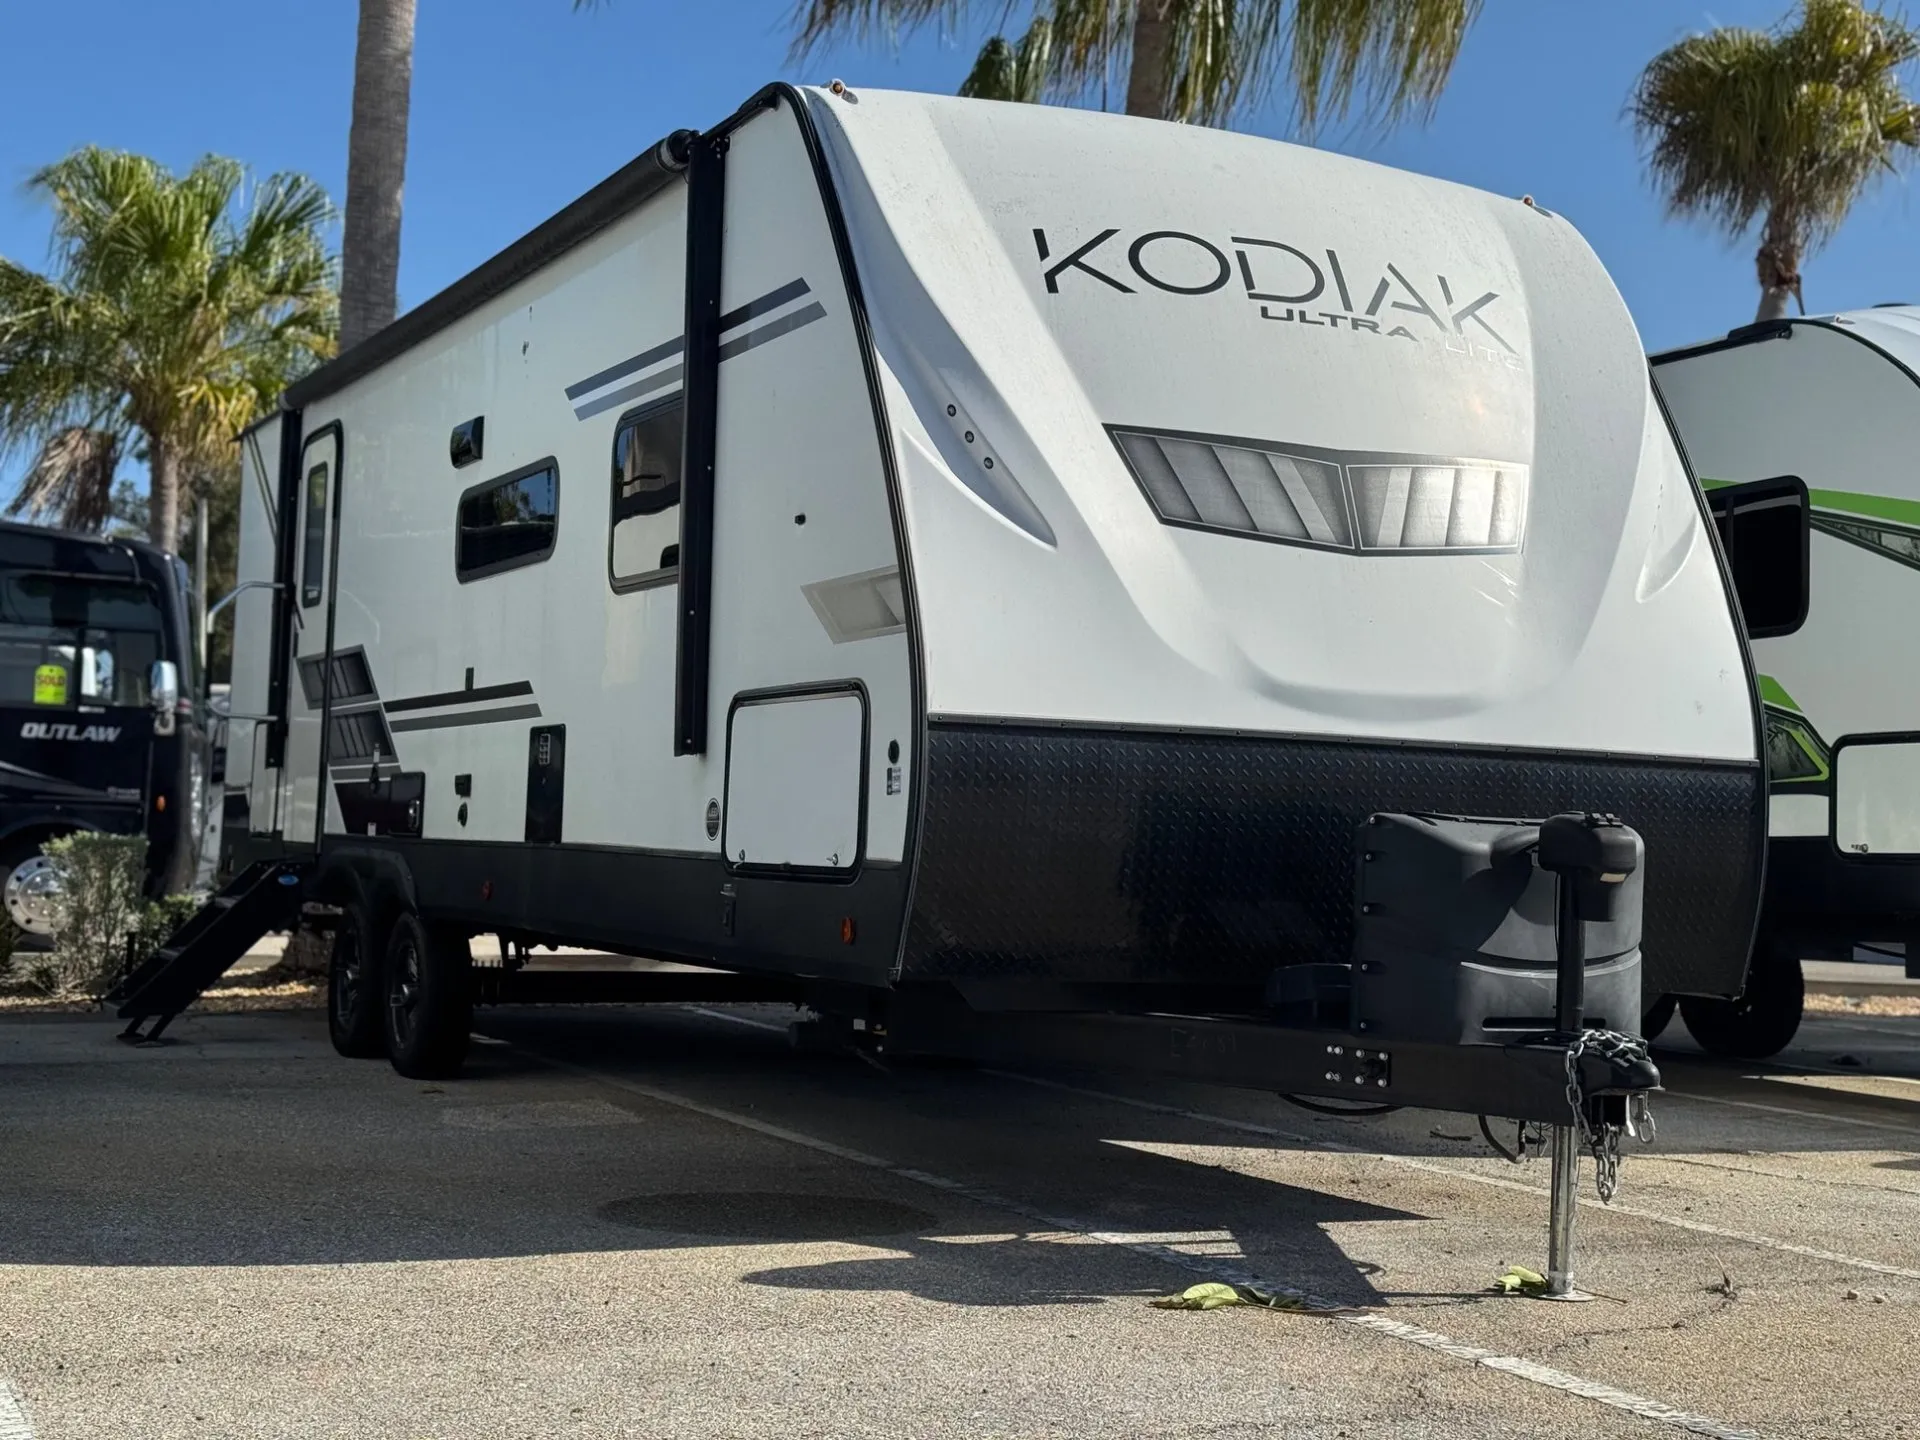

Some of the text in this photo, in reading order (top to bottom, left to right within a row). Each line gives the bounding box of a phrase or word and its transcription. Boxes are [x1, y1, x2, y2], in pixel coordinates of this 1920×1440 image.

[1032, 228, 1520, 356] KODIAK
[1260, 305, 1419, 342] ULTRA
[20, 722, 122, 742] OUTLAW
